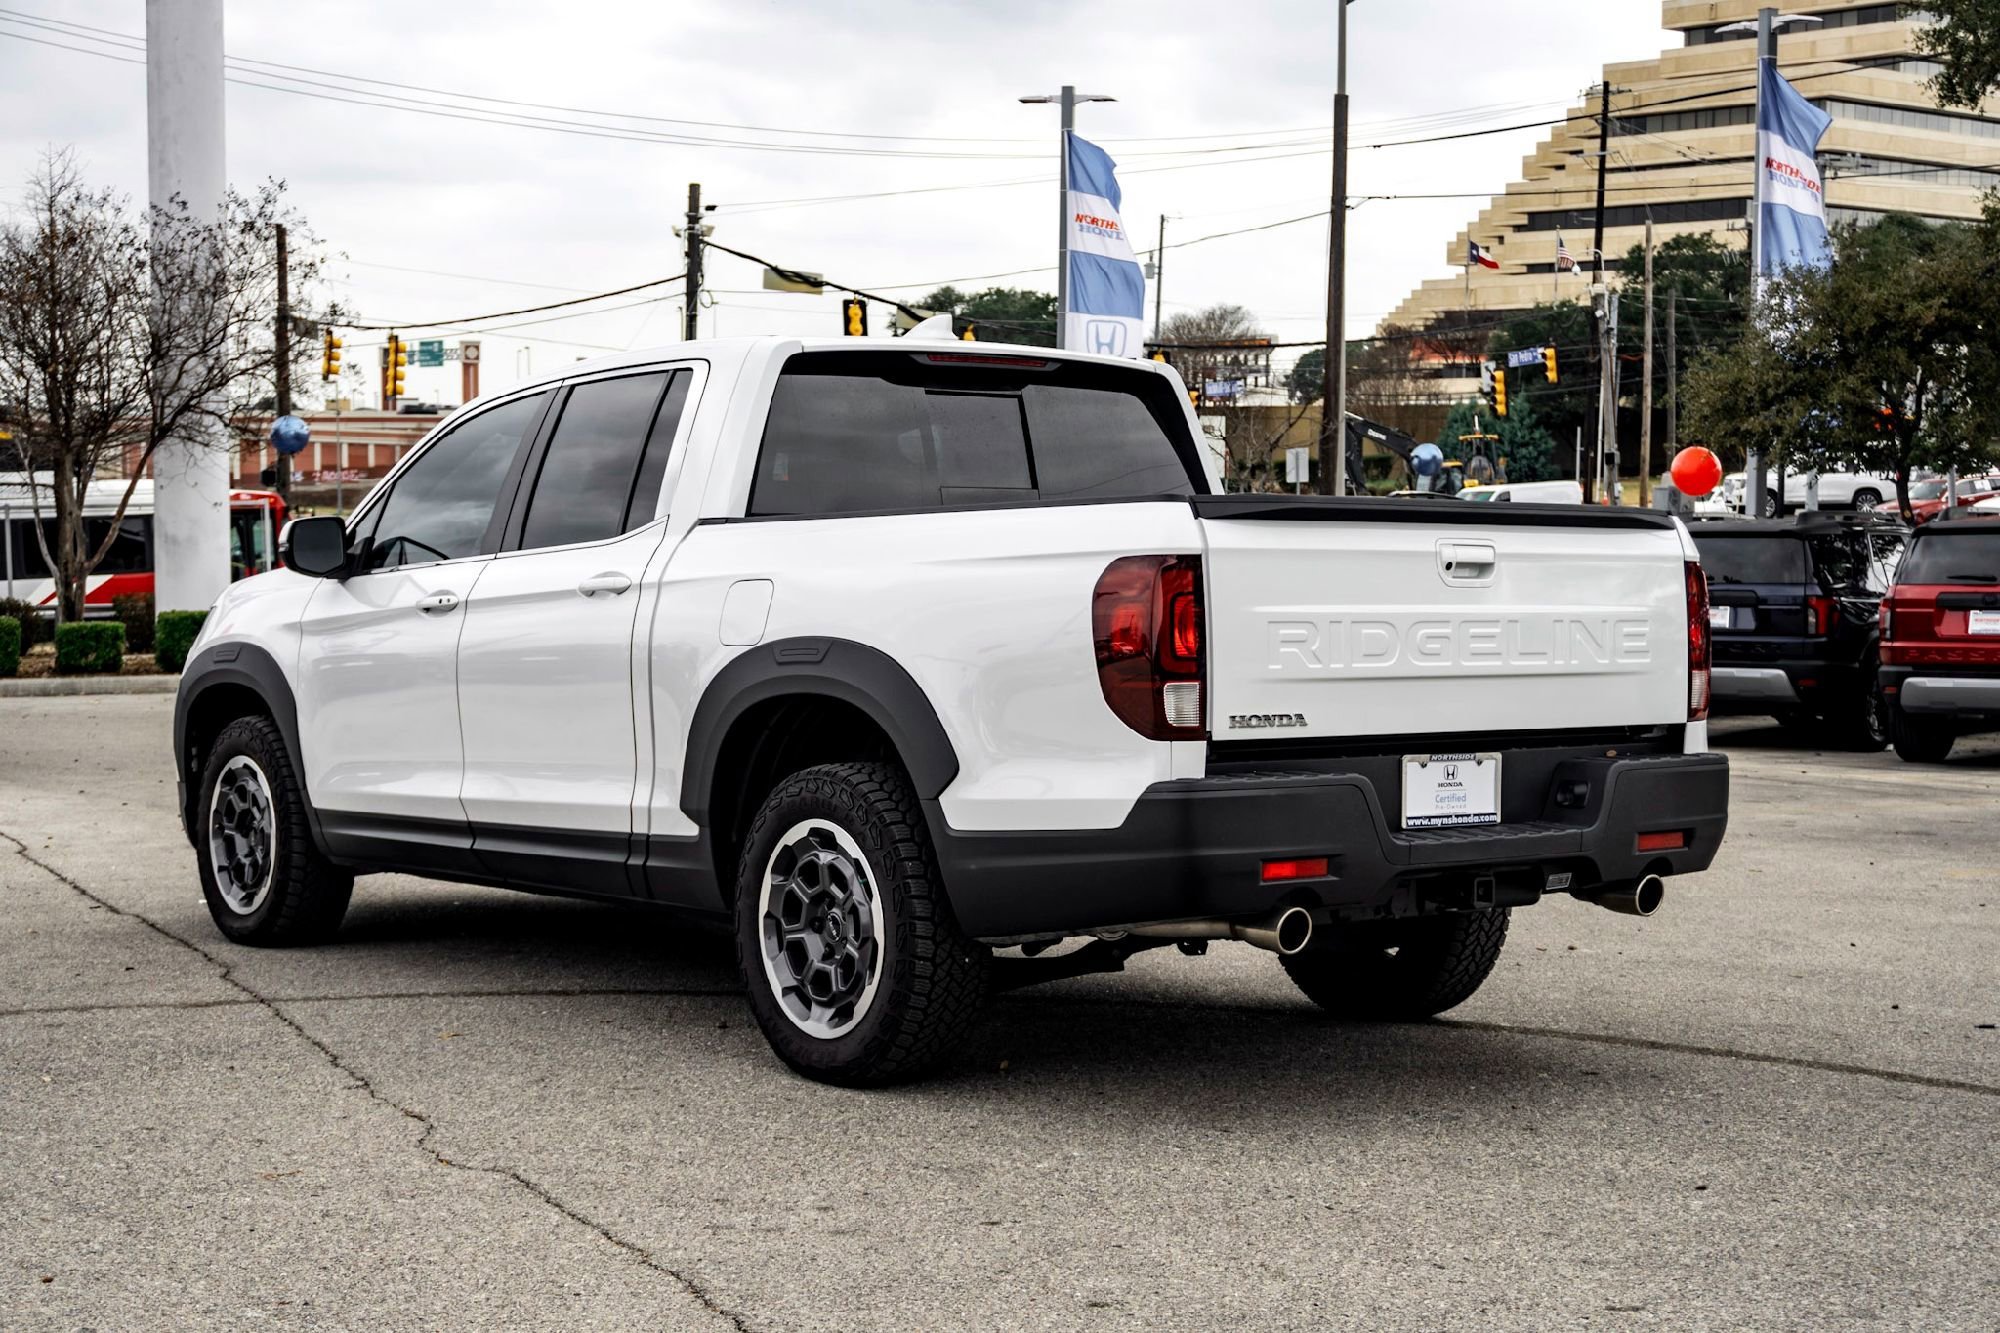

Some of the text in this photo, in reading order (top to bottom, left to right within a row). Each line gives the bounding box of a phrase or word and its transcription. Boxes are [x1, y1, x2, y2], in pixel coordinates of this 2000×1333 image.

[1267, 619, 1651, 669] RIDGELINE
[1228, 713, 1308, 729] HONDA
[1435, 792, 1467, 804] Certified
[1407, 814, 1497, 826] www.mynshonda.com
